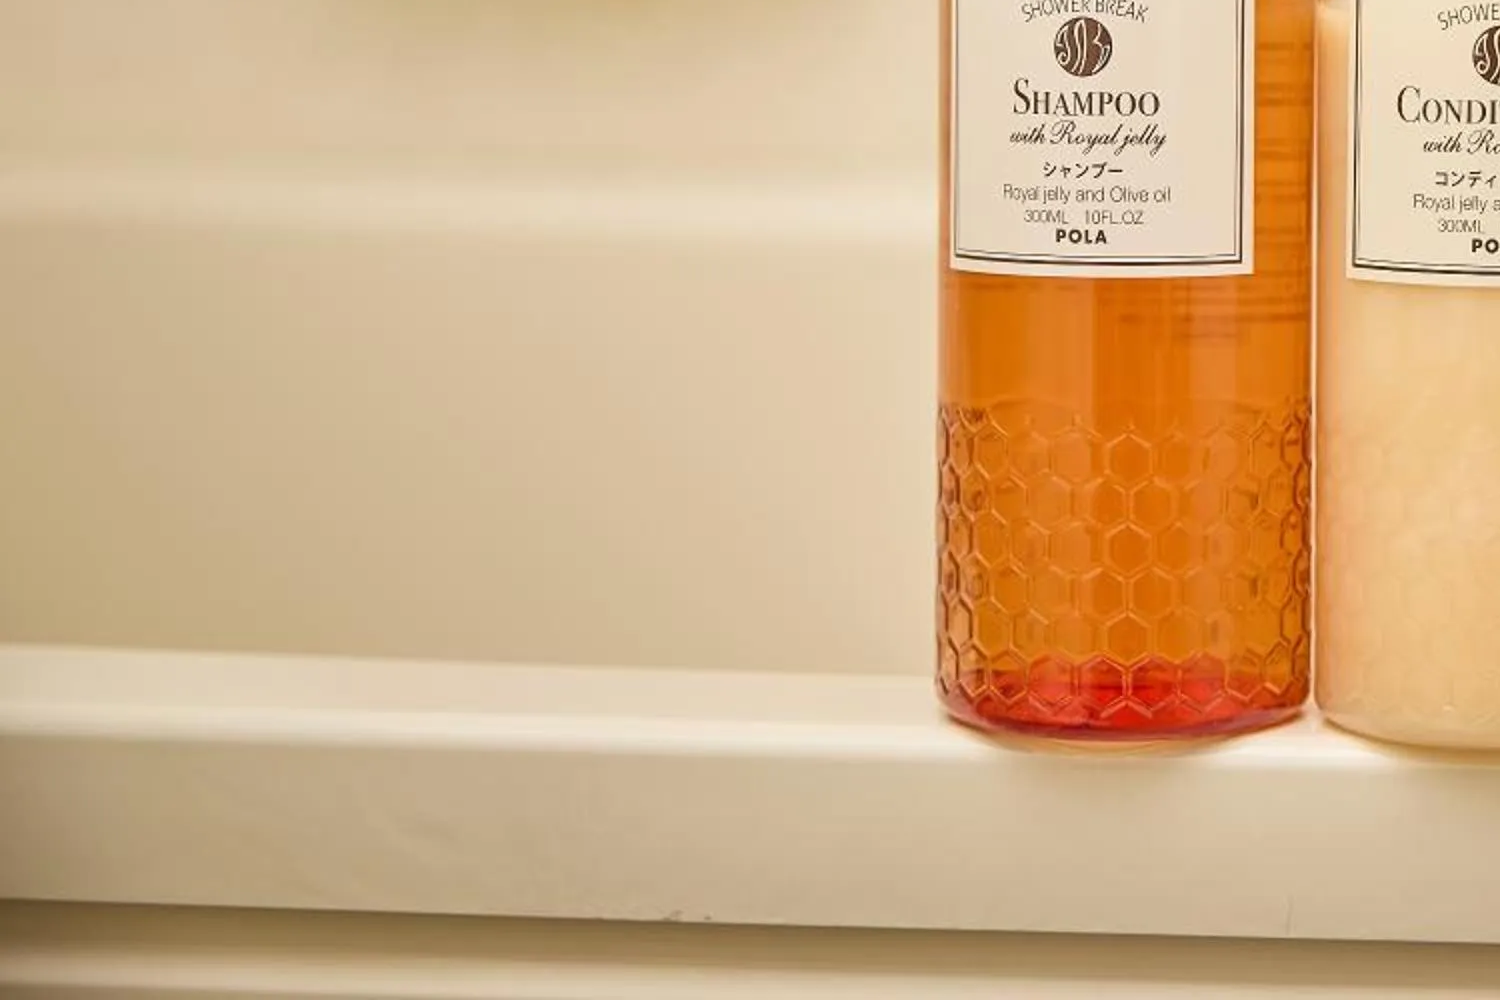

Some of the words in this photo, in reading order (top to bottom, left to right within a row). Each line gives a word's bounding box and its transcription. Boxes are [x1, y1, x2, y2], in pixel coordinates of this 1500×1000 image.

[1013, 78, 1160, 116] SHAMPOO
[1010, 123, 1045, 145] with
[1050, 120, 1119, 155] Royal
[1114, 125, 1166, 155] jelly
[1423, 133, 1462, 154] with
[1003, 184, 1039, 203] Royal
[1043, 184, 1070, 204] jelly
[1075, 186, 1104, 203] and
[1110, 186, 1148, 203] Olive
[1153, 187, 1171, 203] oil
[1413, 194, 1455, 213] Royal
[1459, 194, 1487, 214] jelly
[1024, 210, 1068, 224] 300ML
[1085, 210, 1144, 225] 10FL.OZ
[1437, 220, 1485, 234] 300ML
[1055, 230, 1107, 244] POLA
